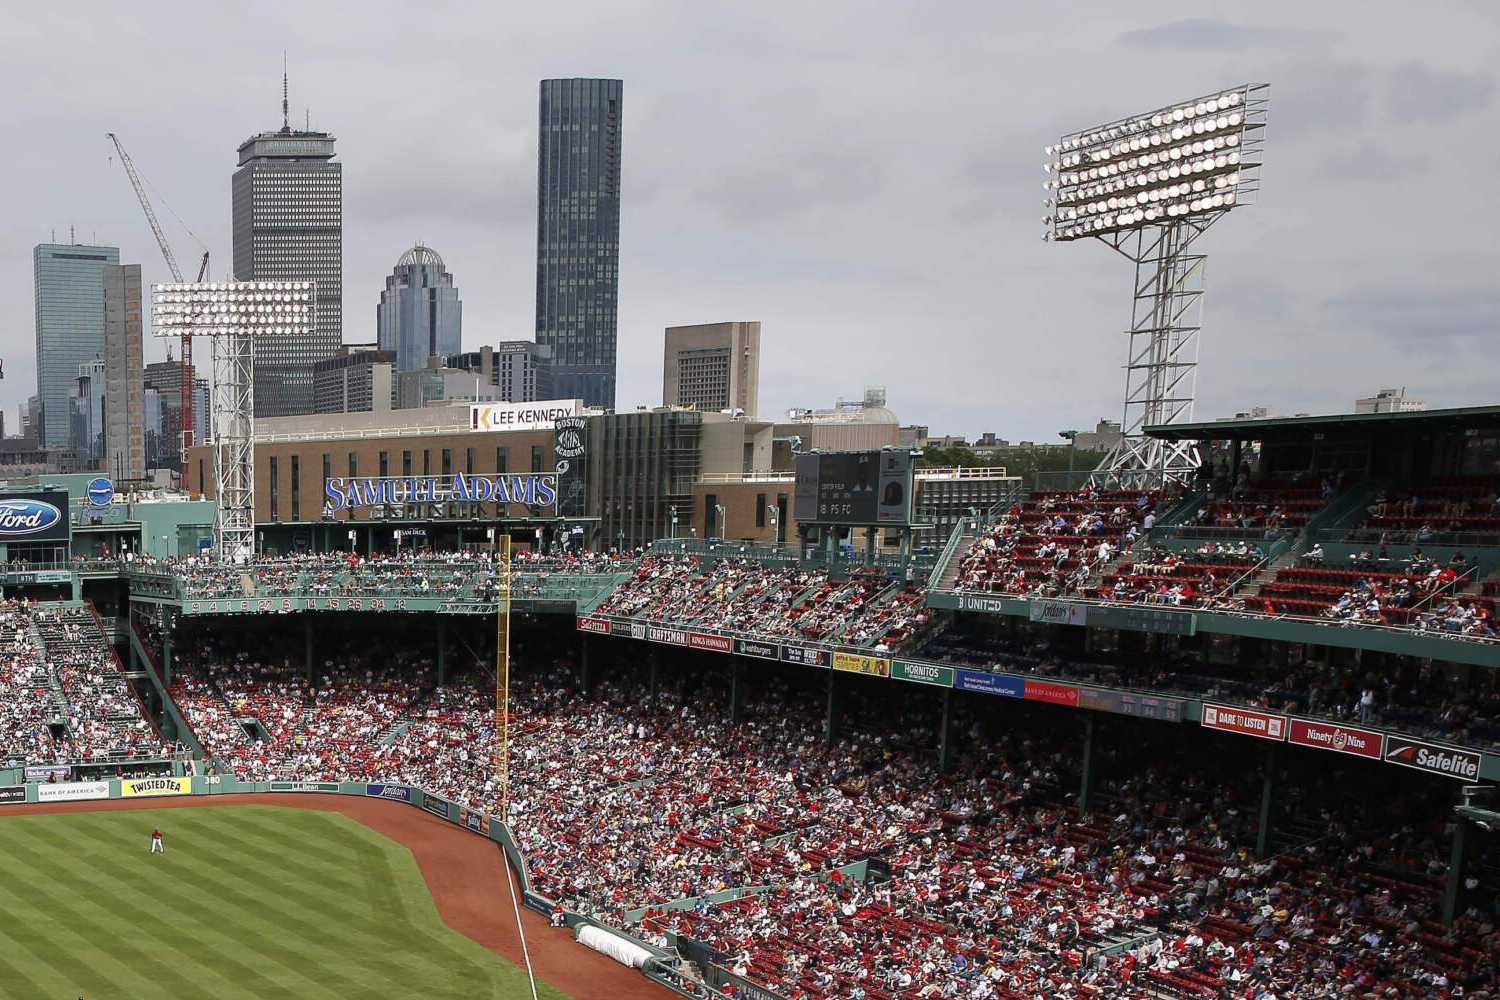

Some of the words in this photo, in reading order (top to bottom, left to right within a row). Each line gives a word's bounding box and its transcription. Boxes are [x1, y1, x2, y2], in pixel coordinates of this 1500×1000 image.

[493, 410, 515, 425] LEE
[518, 407, 572, 424] KENNEDY
[555, 418, 586, 430] BOSTON
[554, 445, 585, 458] ACADEMY
[325, 476, 445, 512] SAMUEL
[450, 471, 556, 506] ADAMS
[257, 599, 273, 611] 27
[305, 598, 316, 610] 14
[347, 598, 362, 611] 26
[370, 598, 386, 610] 34
[394, 599, 406, 610] 42
[967, 599, 1002, 612] UNITED
[649, 628, 686, 644] CRAFTSMAN
[904, 664, 940, 678] HORNITOS
[1219, 712, 1236, 725] DARE
[1236, 715, 1244, 726] TO
[1244, 716, 1266, 731] LISTEN
[1307, 728, 1332, 744] Ninety
[1347, 735, 1366, 749] Nine
[1416, 748, 1477, 777] Safelite
[130, 780, 165, 794] TWISTED
[166, 779, 181, 792] TEA
[204, 776, 221, 785] 380
